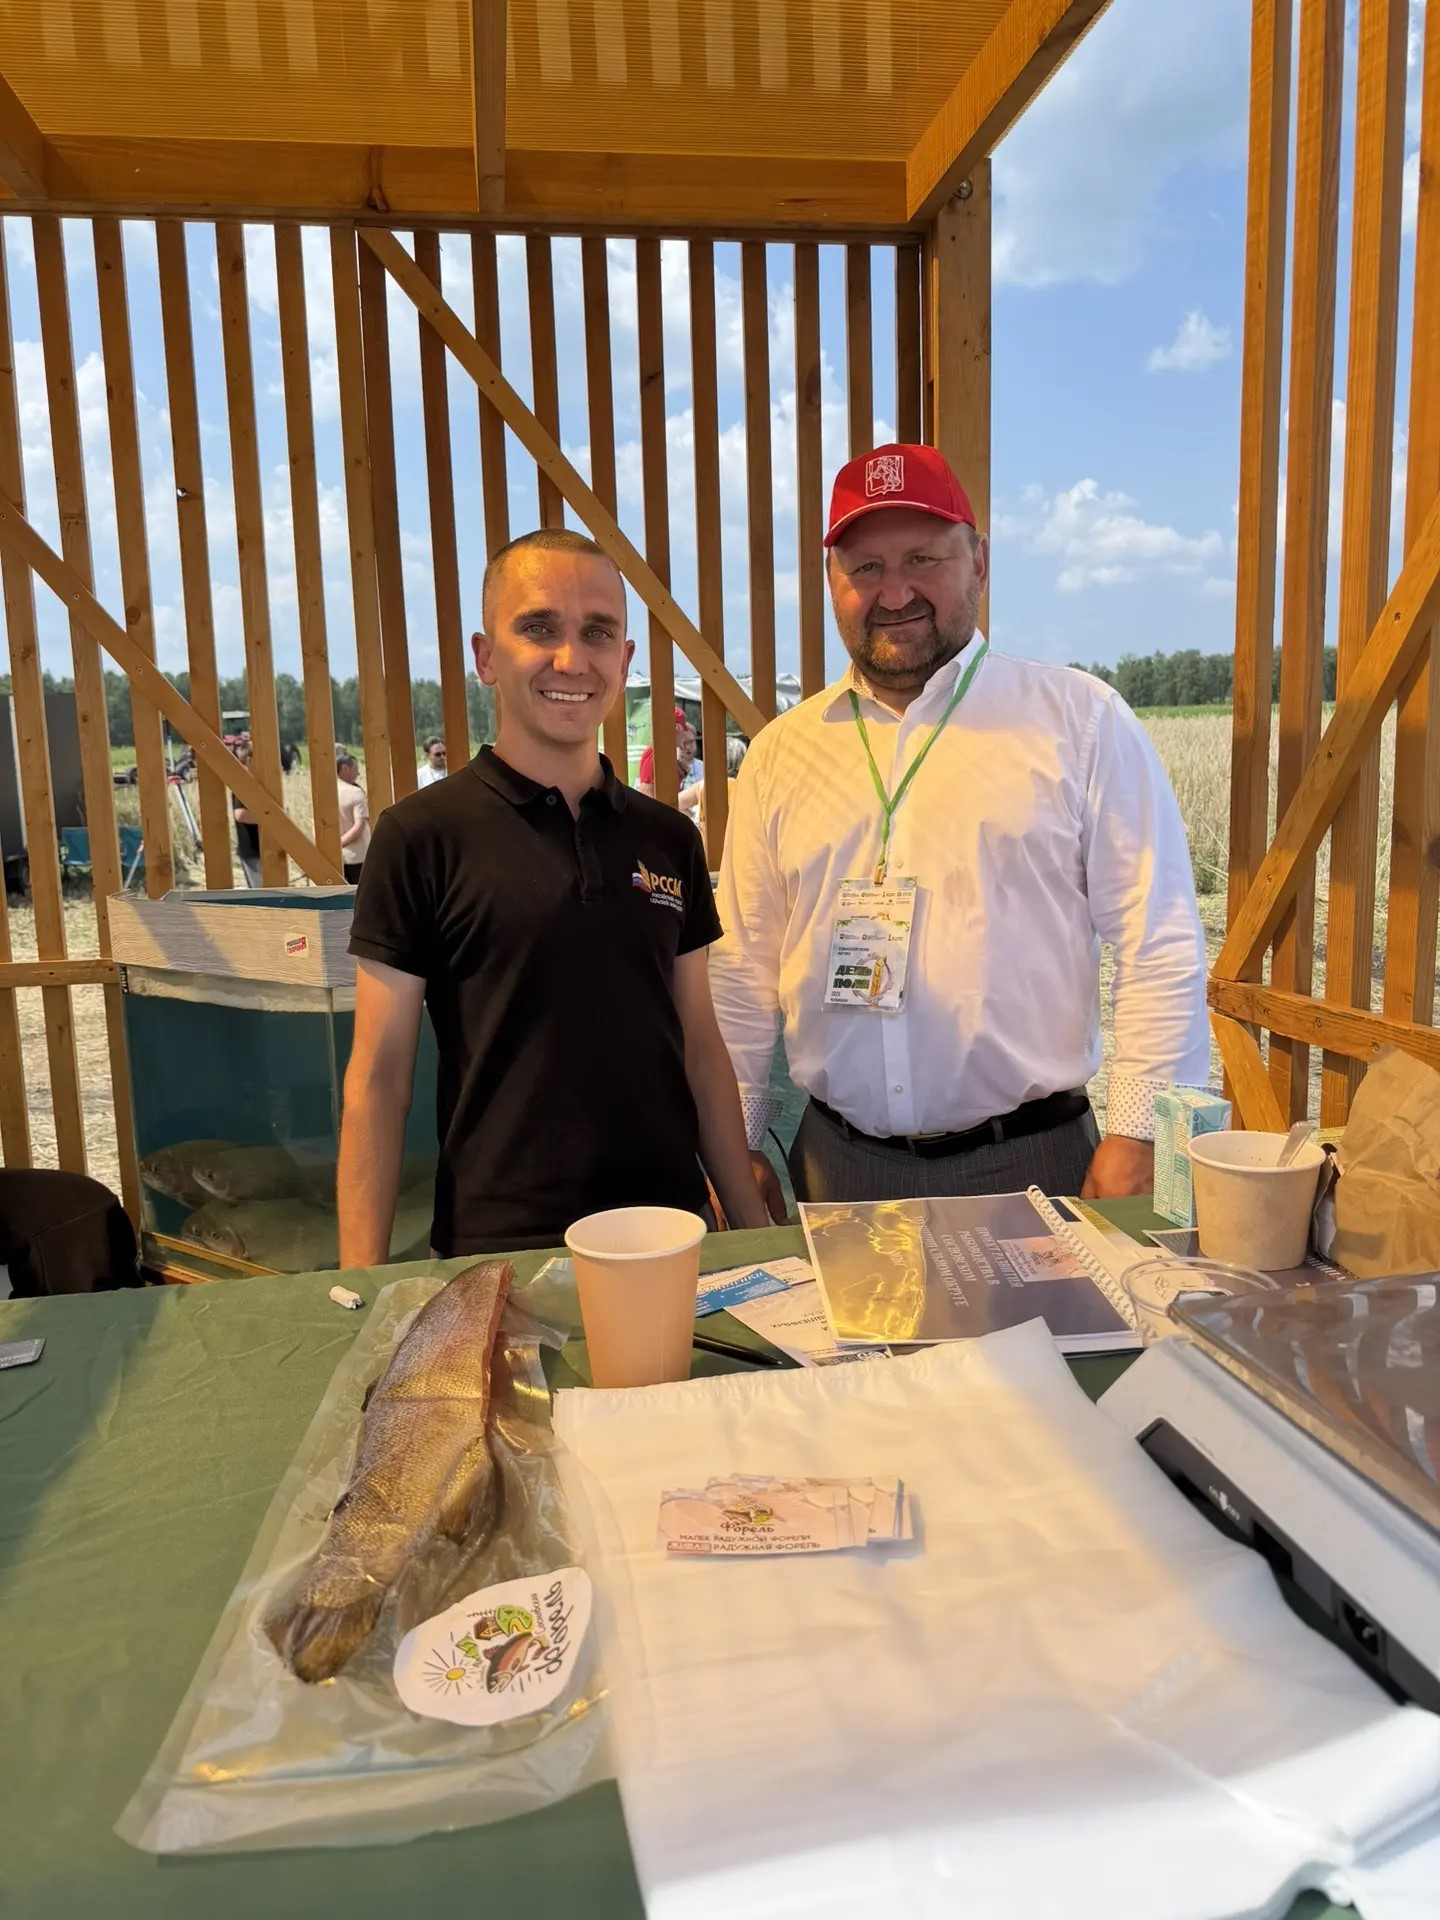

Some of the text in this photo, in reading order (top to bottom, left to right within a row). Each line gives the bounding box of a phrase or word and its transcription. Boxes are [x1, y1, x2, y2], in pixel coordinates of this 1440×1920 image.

[650, 872, 682, 898] РССМ
[974, 1226, 1001, 1251] ПРОЕКТ
[941, 1234, 977, 1281] СОСНОВСКОМ
[956, 1230, 996, 1277] РЫБОВОДСТВА
[941, 1277, 969, 1306] ОКРУГЕ
[714, 1543, 771, 1551] РАДУЖНАЯ
[775, 1541, 820, 1549] ФОРЕЛЬ
[771, 1534, 810, 1542] ФОРЕЛИ
